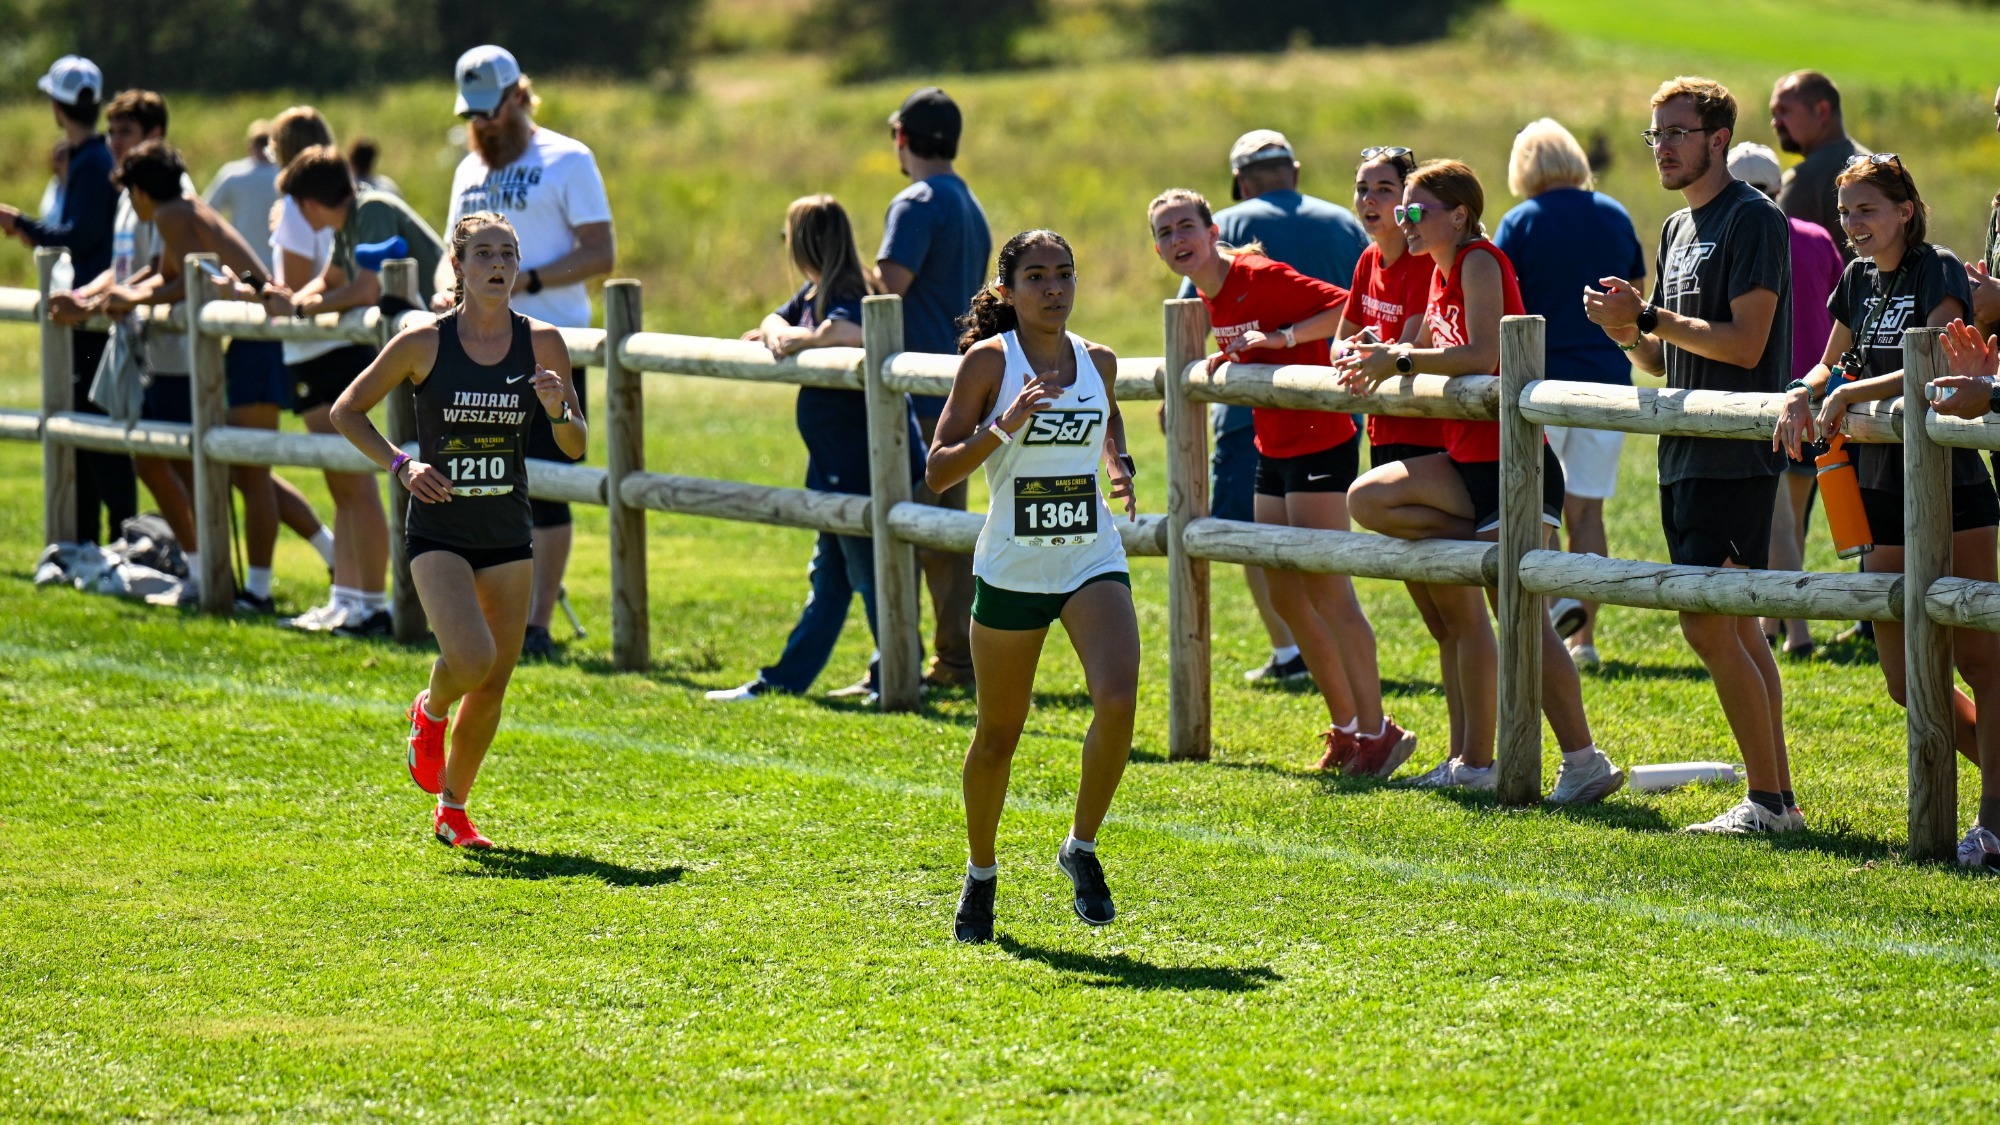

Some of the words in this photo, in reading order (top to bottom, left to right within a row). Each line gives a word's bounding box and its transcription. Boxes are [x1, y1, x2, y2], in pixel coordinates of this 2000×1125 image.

[453, 391, 519, 408] INDIANA
[443, 408, 526, 425] WESLEYAN
[1025, 411, 1101, 443] S&T
[447, 457, 505, 480] 1210
[1025, 501, 1089, 528] 1364
